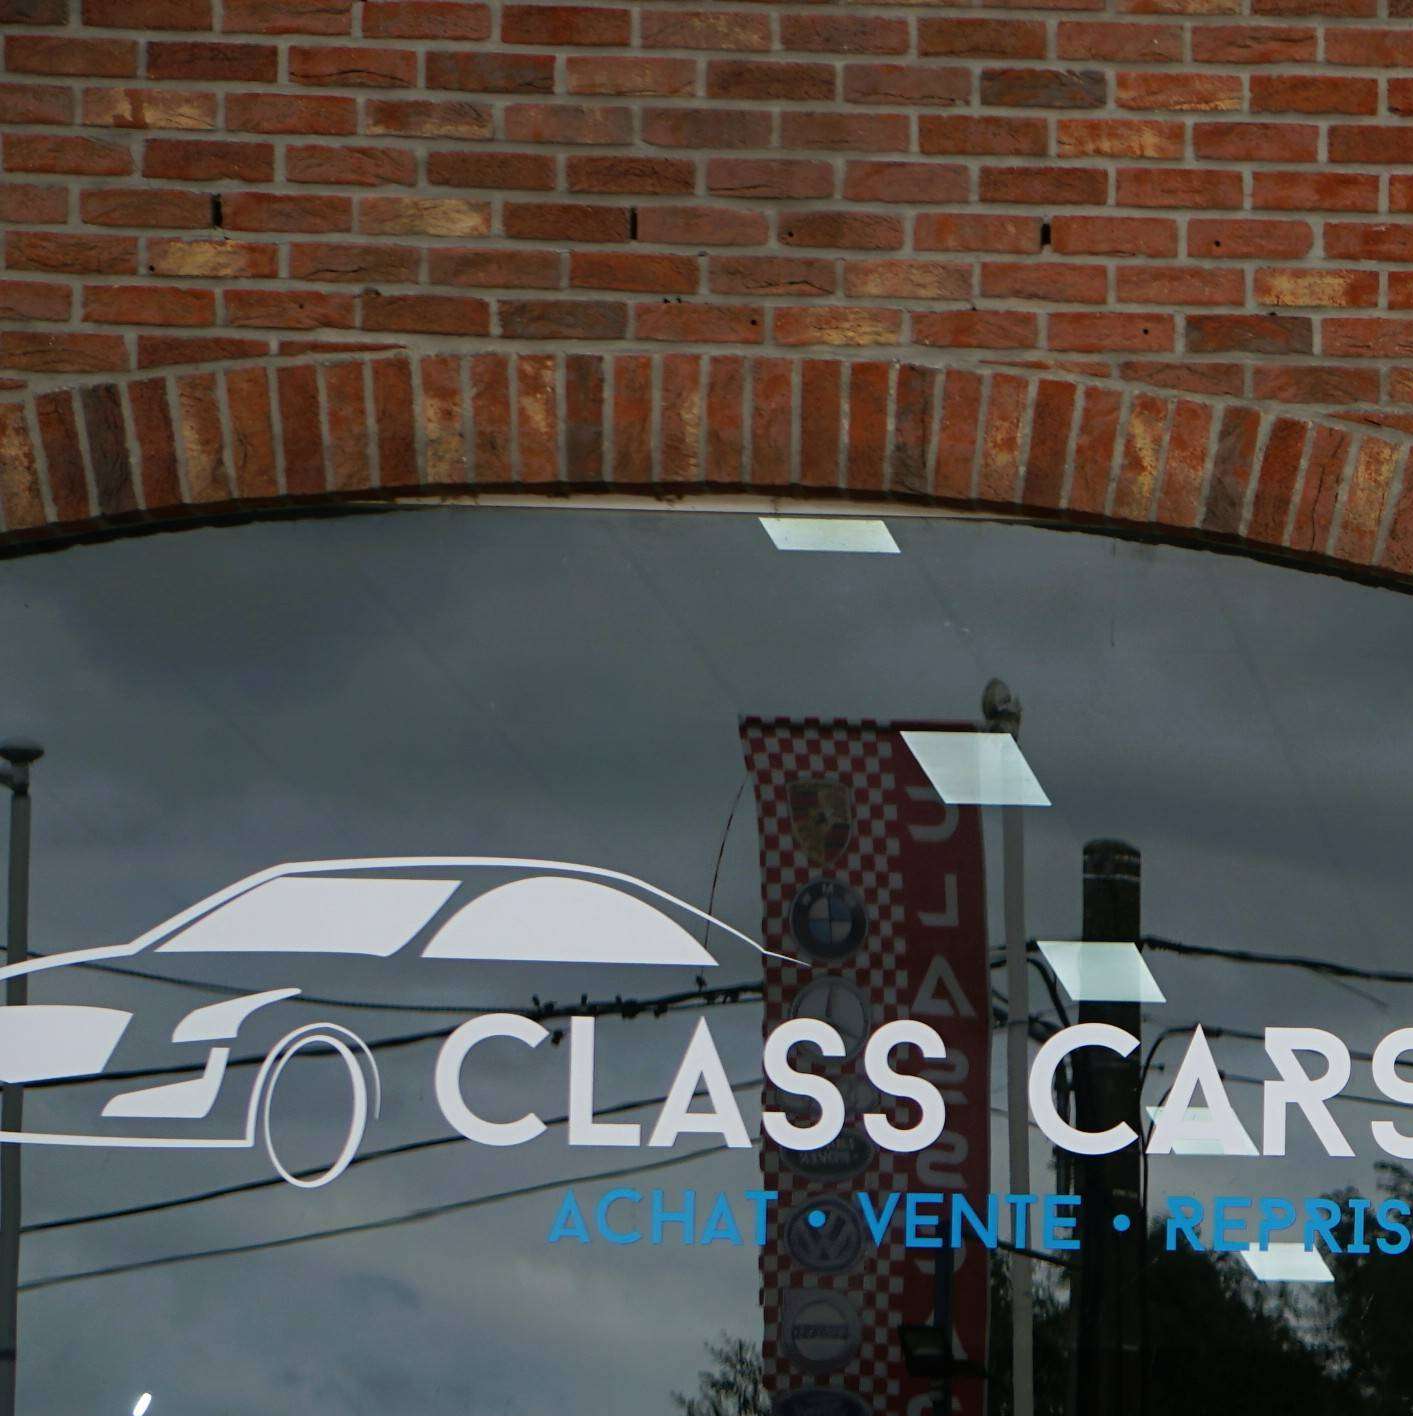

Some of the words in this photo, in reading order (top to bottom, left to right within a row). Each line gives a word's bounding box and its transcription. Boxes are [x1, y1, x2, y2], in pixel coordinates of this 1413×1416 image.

[435, 1013, 947, 1152] CLASS
[548, 1187, 779, 1246] ACHAT
[856, 1191, 1082, 1250] VENTE
